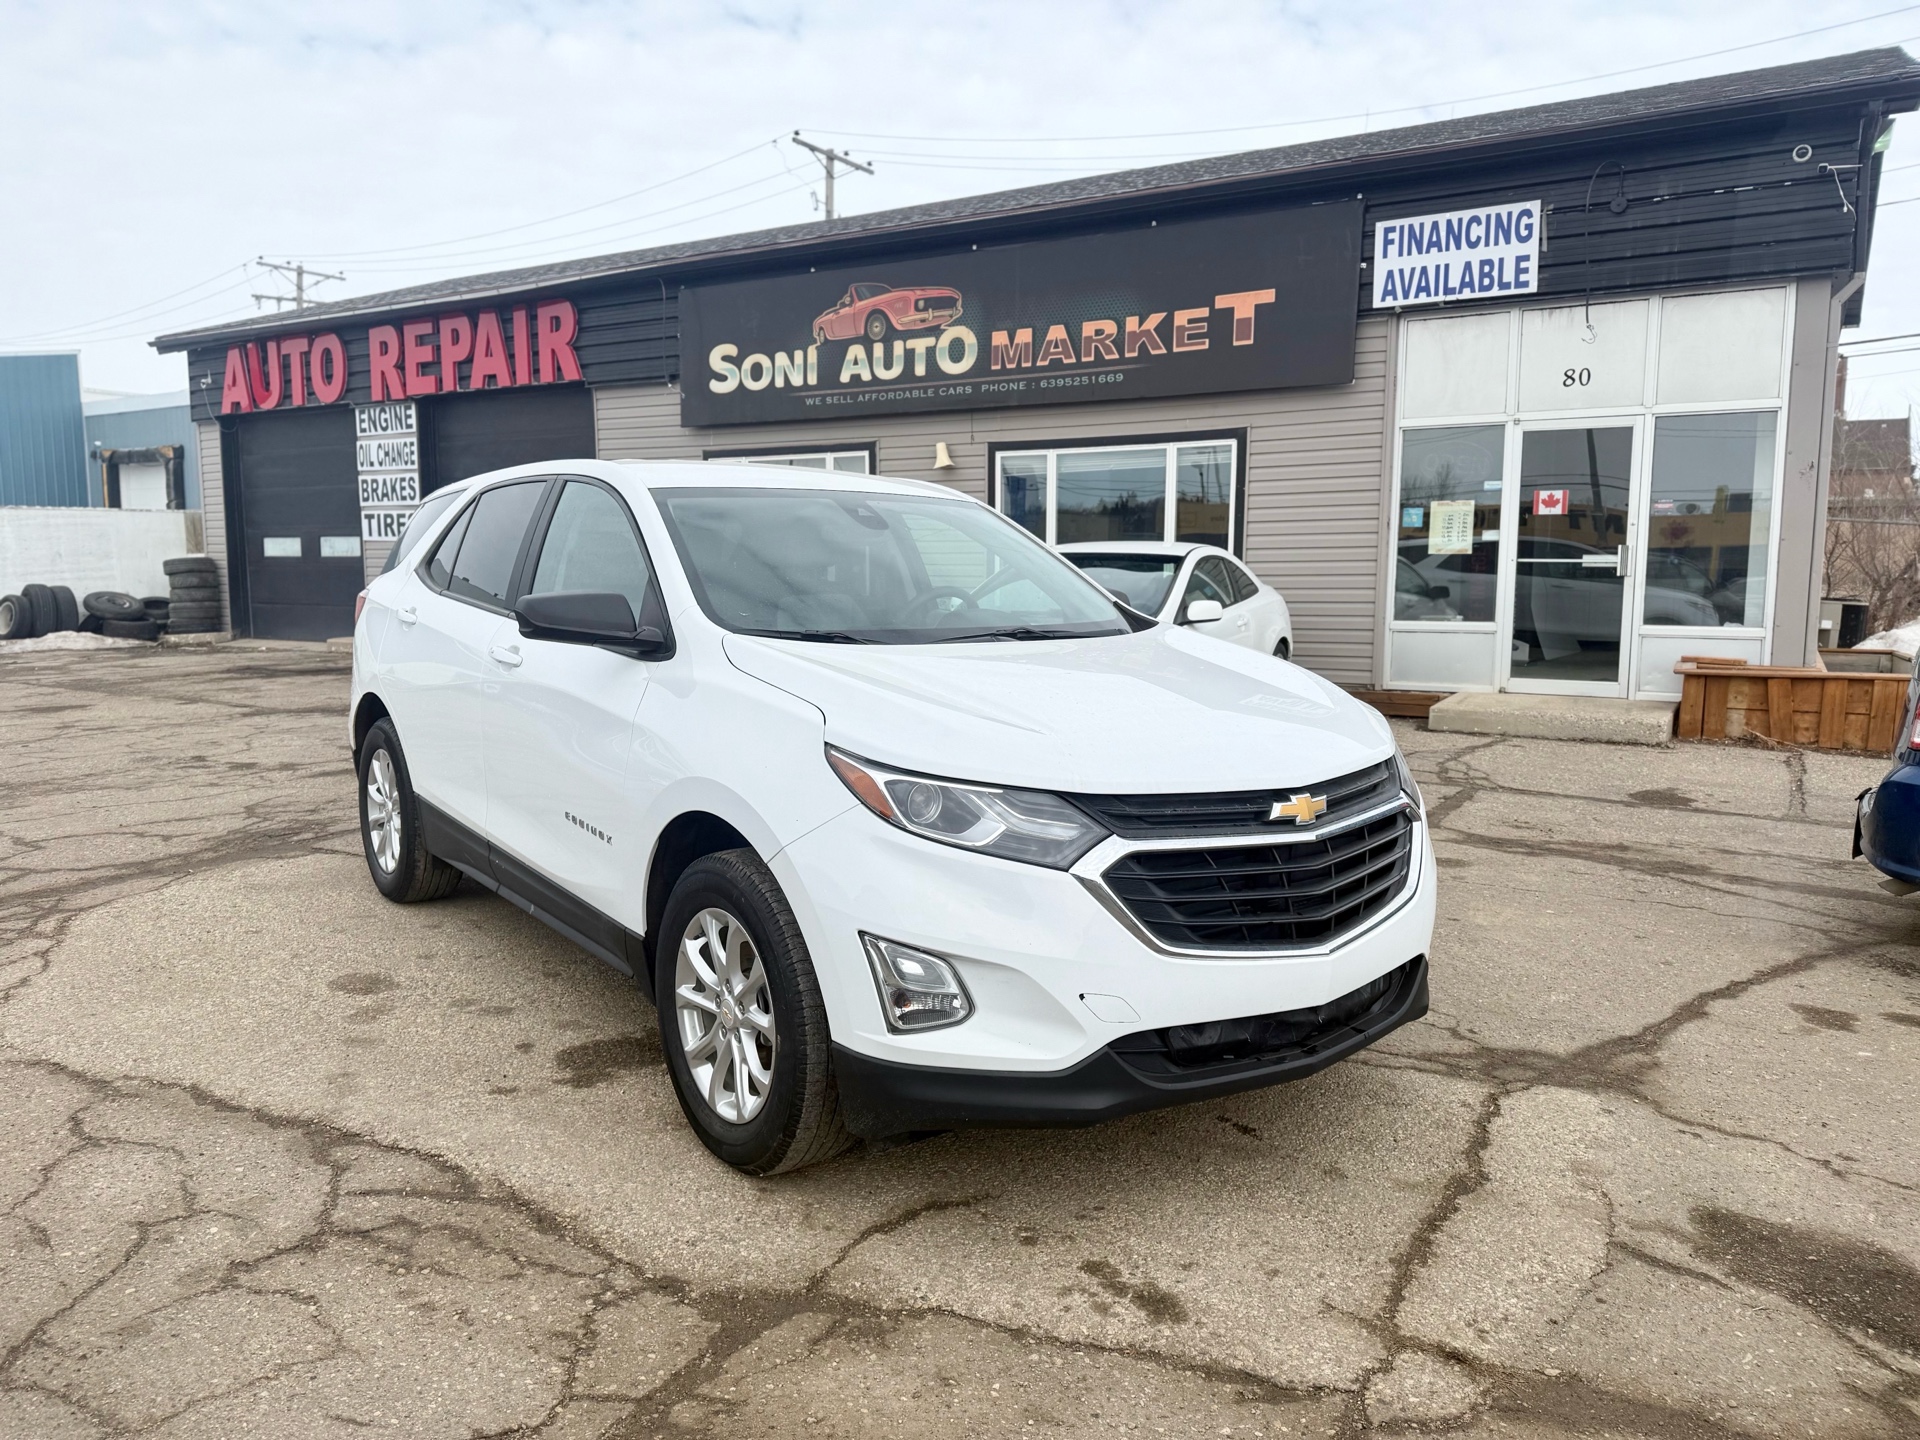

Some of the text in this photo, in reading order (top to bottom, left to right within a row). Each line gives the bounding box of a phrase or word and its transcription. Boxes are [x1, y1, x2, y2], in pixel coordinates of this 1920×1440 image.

[1382, 208, 1534, 259] FINANCING
[1380, 254, 1531, 302] AVAILABLE
[221, 298, 584, 414] AUTO REPAIR
[708, 288, 1276, 394] SONI AUTO MARKET
[805, 397, 822, 406] WE
[826, 396, 853, 404] SELL
[857, 389, 935, 402] AFFORDABLE
[939, 385, 972, 396] CARS
[981, 381, 1027, 393] PHONE
[1040, 373, 1124, 389] 6395251669
[1562, 367, 1592, 388] 80
[358, 404, 414, 434] ENGINE
[359, 441, 416, 468] OIL CHANGE
[360, 476, 417, 503] BRAKES
[364, 513, 414, 538] TIRE
[564, 811, 613, 846] EQUINOX
